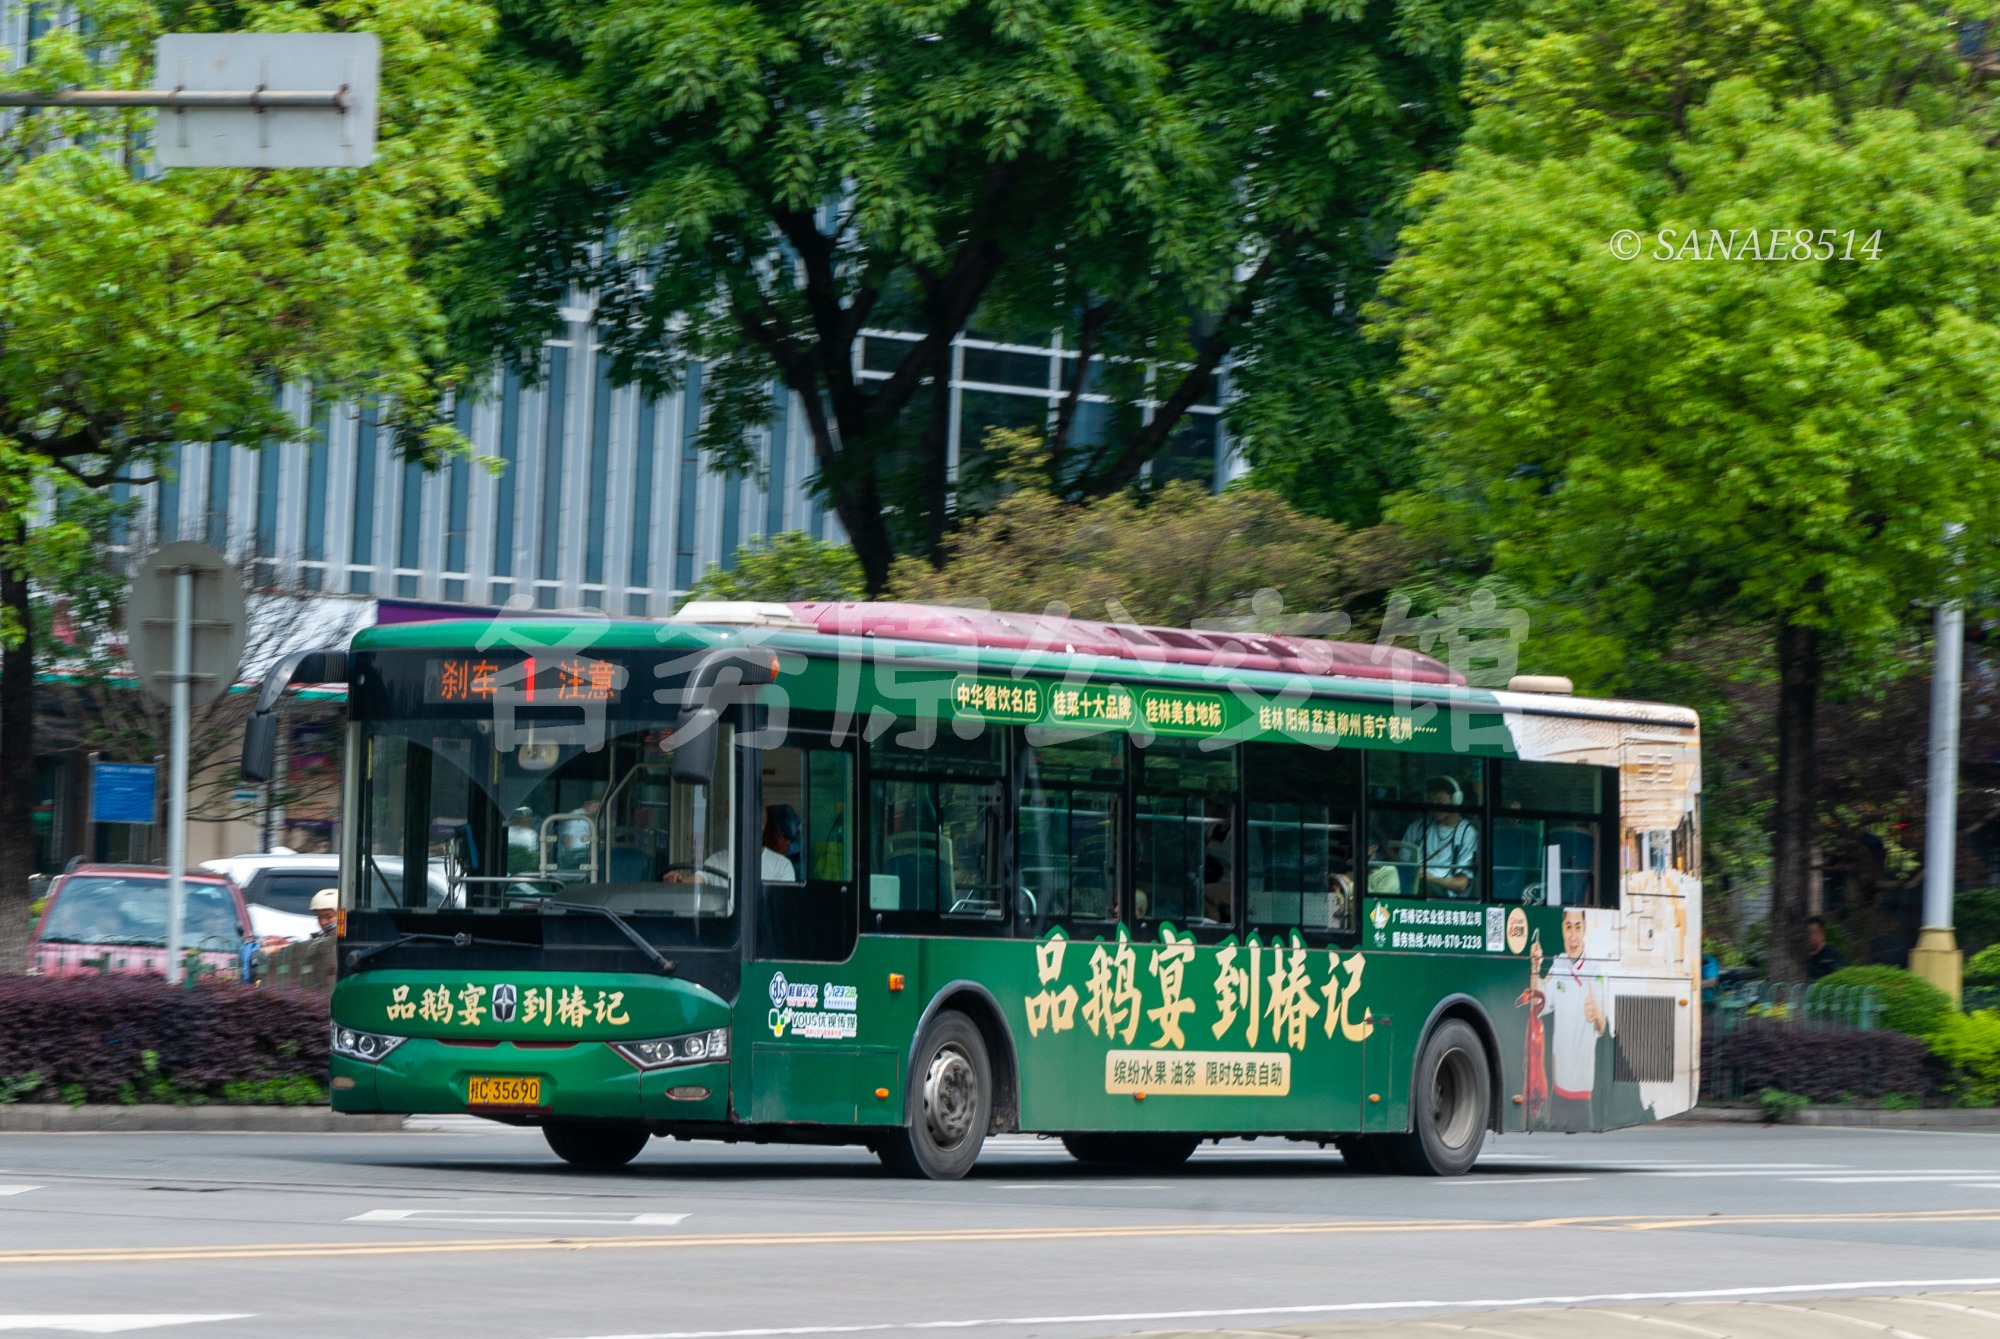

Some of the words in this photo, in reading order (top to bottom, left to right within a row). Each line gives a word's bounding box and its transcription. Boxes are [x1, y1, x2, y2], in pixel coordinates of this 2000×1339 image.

[441, 659, 498, 700] 刹车
[523, 656, 535, 702] 1
[558, 659, 616, 700] 注意
[957, 682, 1037, 714] 中华餐饮名店
[1053, 689, 1132, 721] 桂菜十大品牌
[1145, 697, 1221, 727] 桂林美食地标
[1205, 1060, 1283, 1087] 限时免费自助
